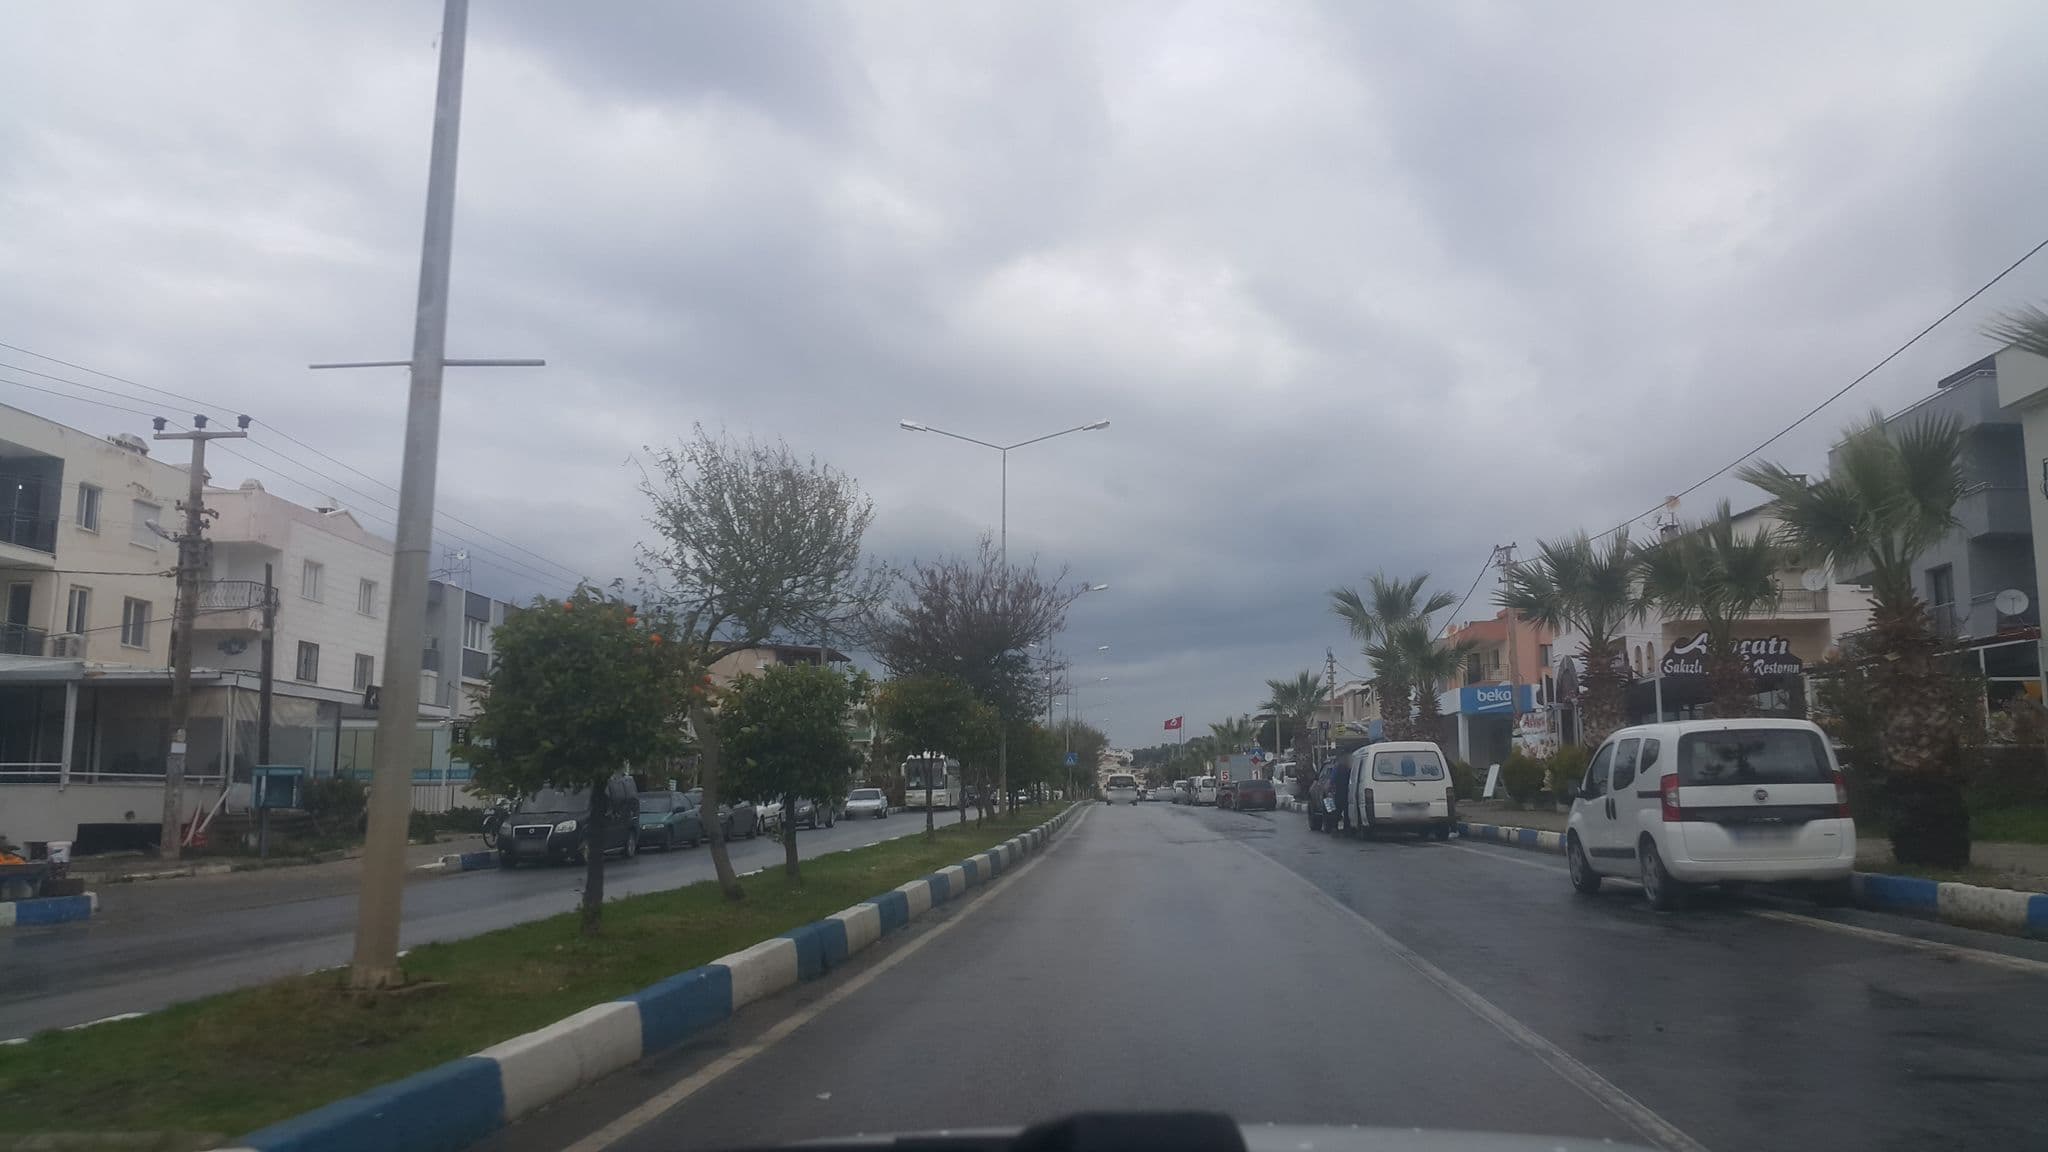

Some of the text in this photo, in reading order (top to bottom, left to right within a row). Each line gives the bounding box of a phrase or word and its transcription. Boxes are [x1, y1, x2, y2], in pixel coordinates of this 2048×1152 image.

[1674, 632, 1788, 660] Açatı
[1753, 658, 1800, 676] Restoran
[1477, 688, 1512, 702] beko
